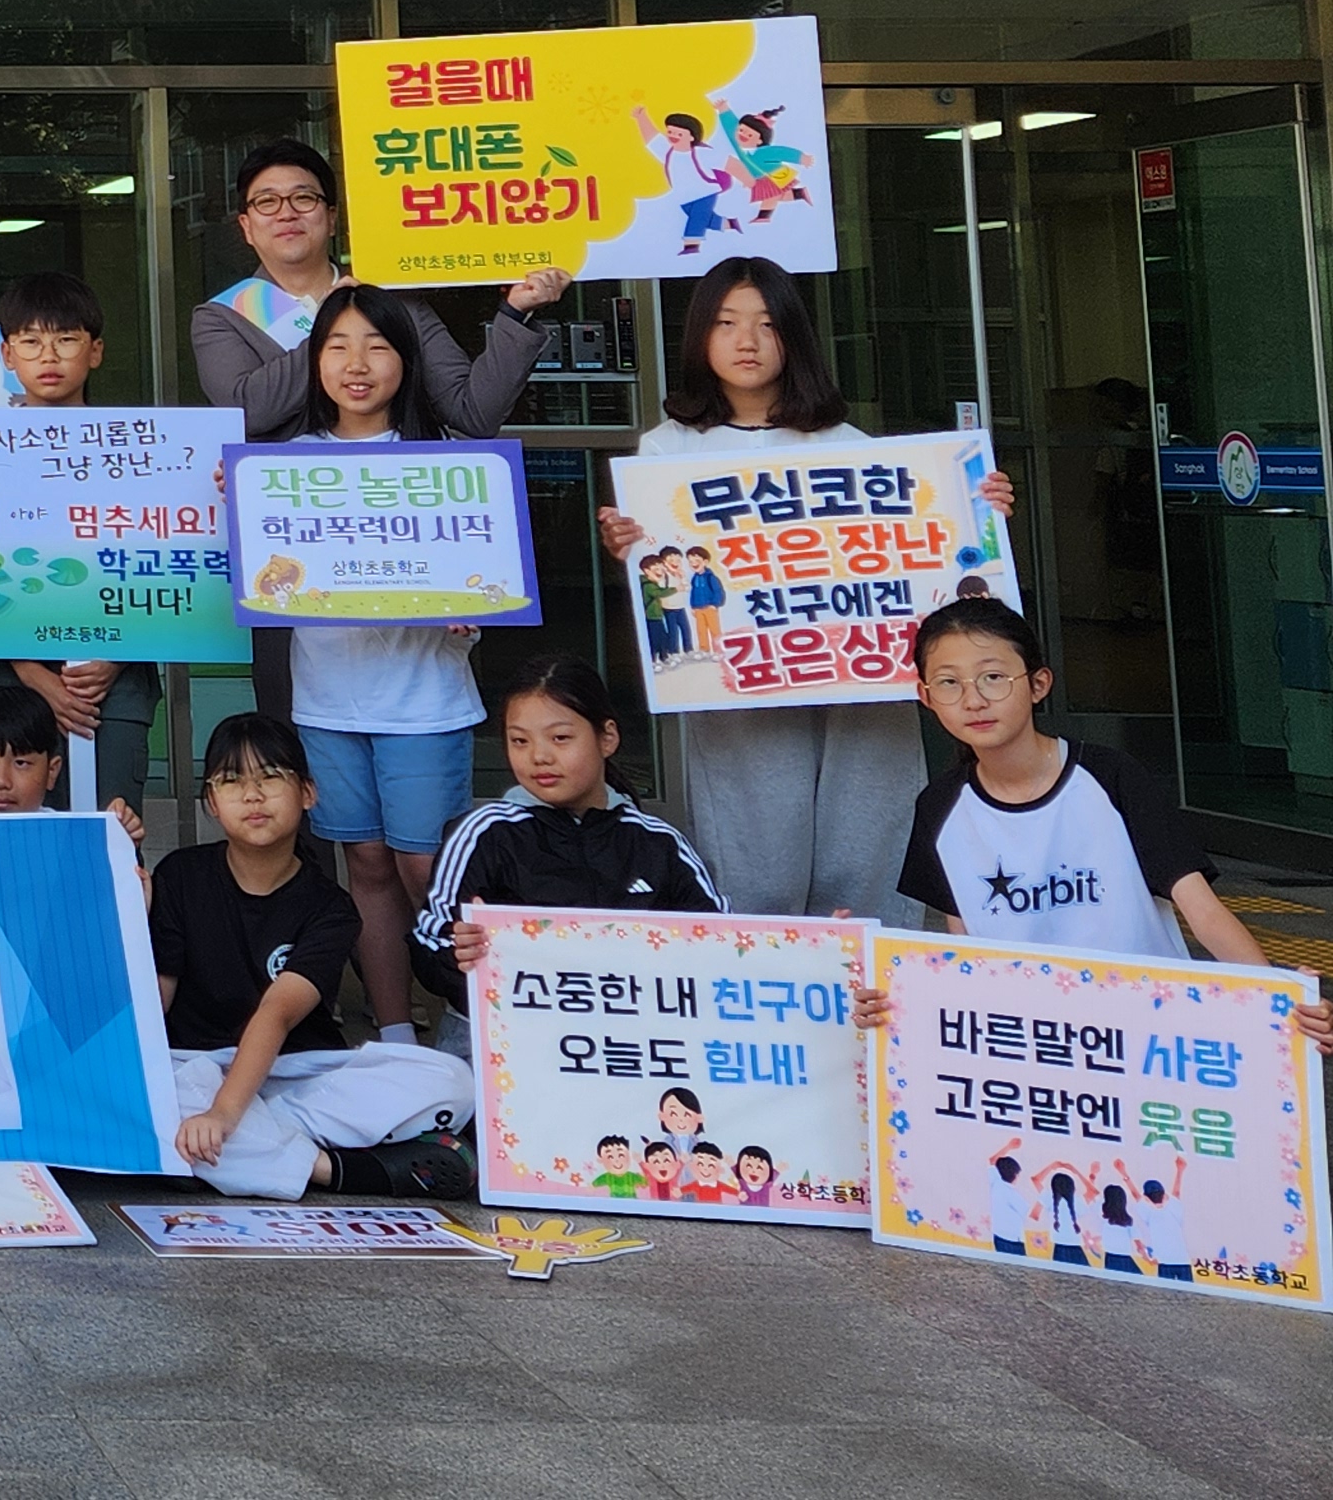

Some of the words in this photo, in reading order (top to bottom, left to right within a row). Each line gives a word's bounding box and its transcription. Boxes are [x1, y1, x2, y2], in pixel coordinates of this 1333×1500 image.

[386, 56, 535, 109] 걸을때
[373, 123, 523, 177] 휴대폰
[401, 175, 601, 228] 보지않기
[397, 252, 486, 272] 상학초등학교
[493, 250, 553, 268] 학부모회
[79, 419, 167, 446] 괴롭힘,
[41, 455, 92, 482] 그냥
[260, 466, 349, 509] 작은
[357, 465, 490, 508] 놀림이
[690, 463, 916, 532] 무심코한
[68, 505, 217, 540] 멈추세요!
[261, 515, 421, 545] 학교폭력의
[430, 514, 494, 544] 시작
[97, 547, 231, 584] 학교폭력
[332, 560, 430, 577] 상학초등학교
[717, 528, 832, 583] 작은
[837, 521, 947, 576] 장난
[99, 587, 193, 616] 입니다!
[745, 579, 915, 629] 친구에겐
[34, 625, 122, 643] 상학초등학교
[723, 625, 834, 691] 깊은
[1009, 870, 1100, 912] orbit
[512, 971, 642, 1016] 소중한
[656, 977, 699, 1019] 내
[712, 978, 849, 1026] 친구야
[559, 1034, 691, 1080] 오늘도
[703, 1041, 807, 1086] 힘내!
[939, 1008, 1126, 1075] 바른말엔
[1142, 1034, 1242, 1089] 사랑
[935, 1073, 1123, 1143] 고운말엔
[1139, 1101, 1236, 1160] 웃음
[780, 1182, 872, 1205] 상학초등학
[267, 1220, 437, 1239] STOP
[1193, 1257, 1310, 1291] 상학초등학교
